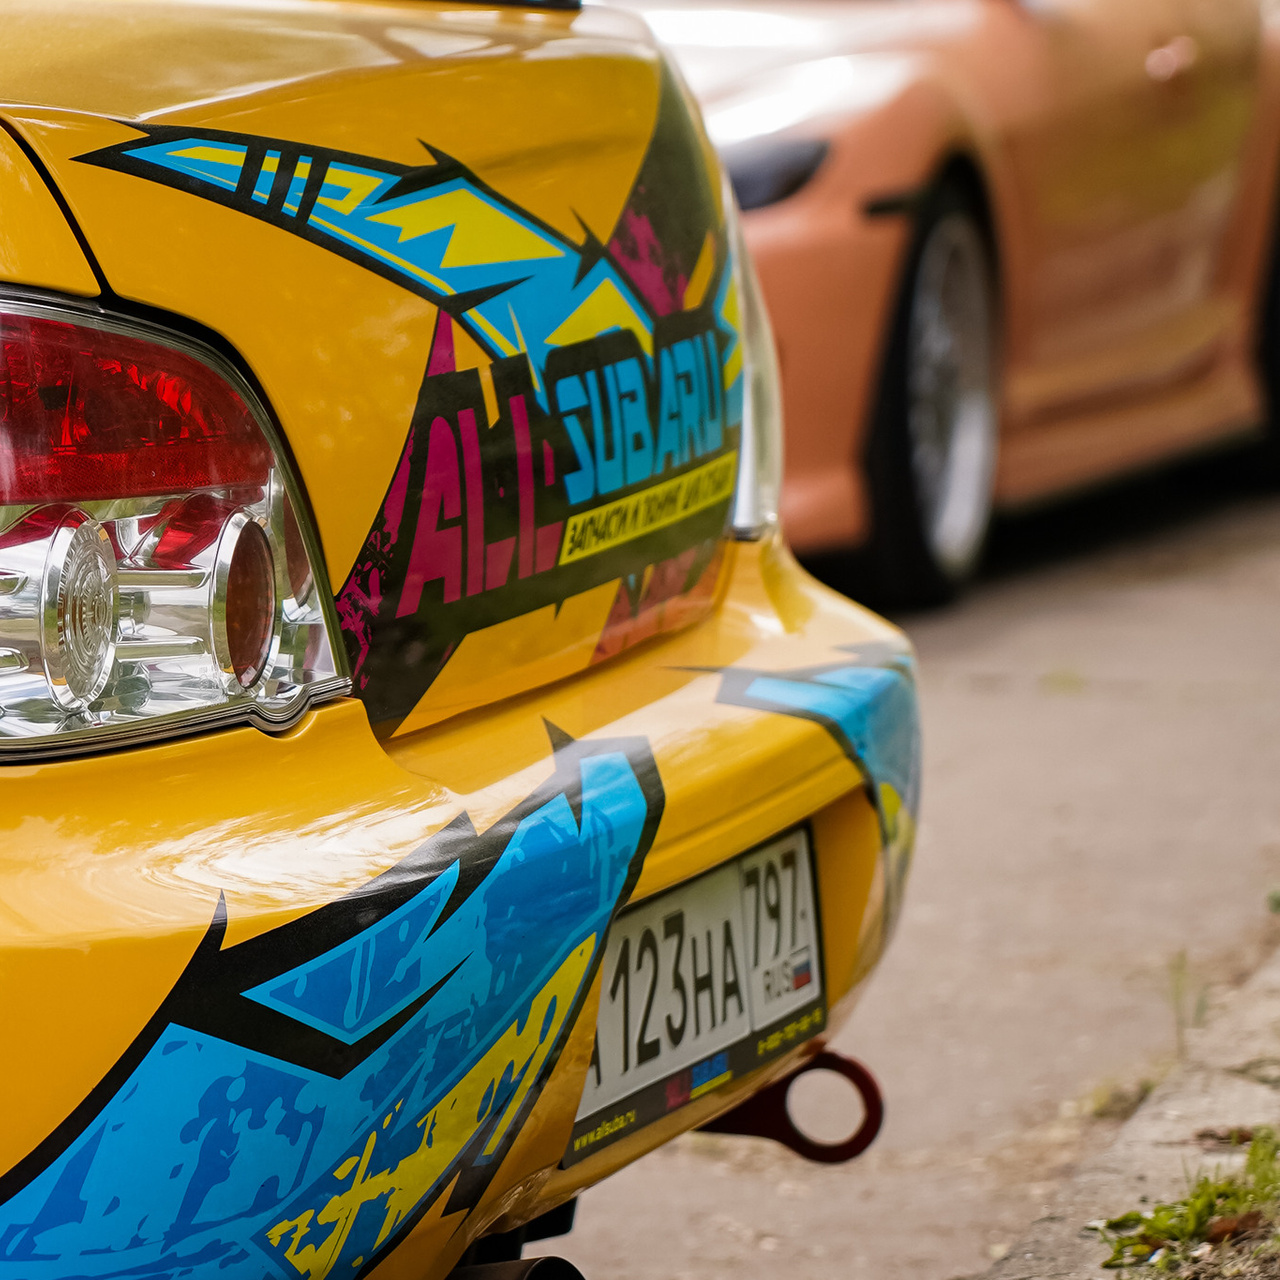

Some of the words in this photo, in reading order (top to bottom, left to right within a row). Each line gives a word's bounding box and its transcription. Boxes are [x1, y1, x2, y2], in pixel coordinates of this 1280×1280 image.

[396, 394, 563, 618] ALL
[556, 330, 723, 505] SUBARU
[743, 848, 797, 969] 797
